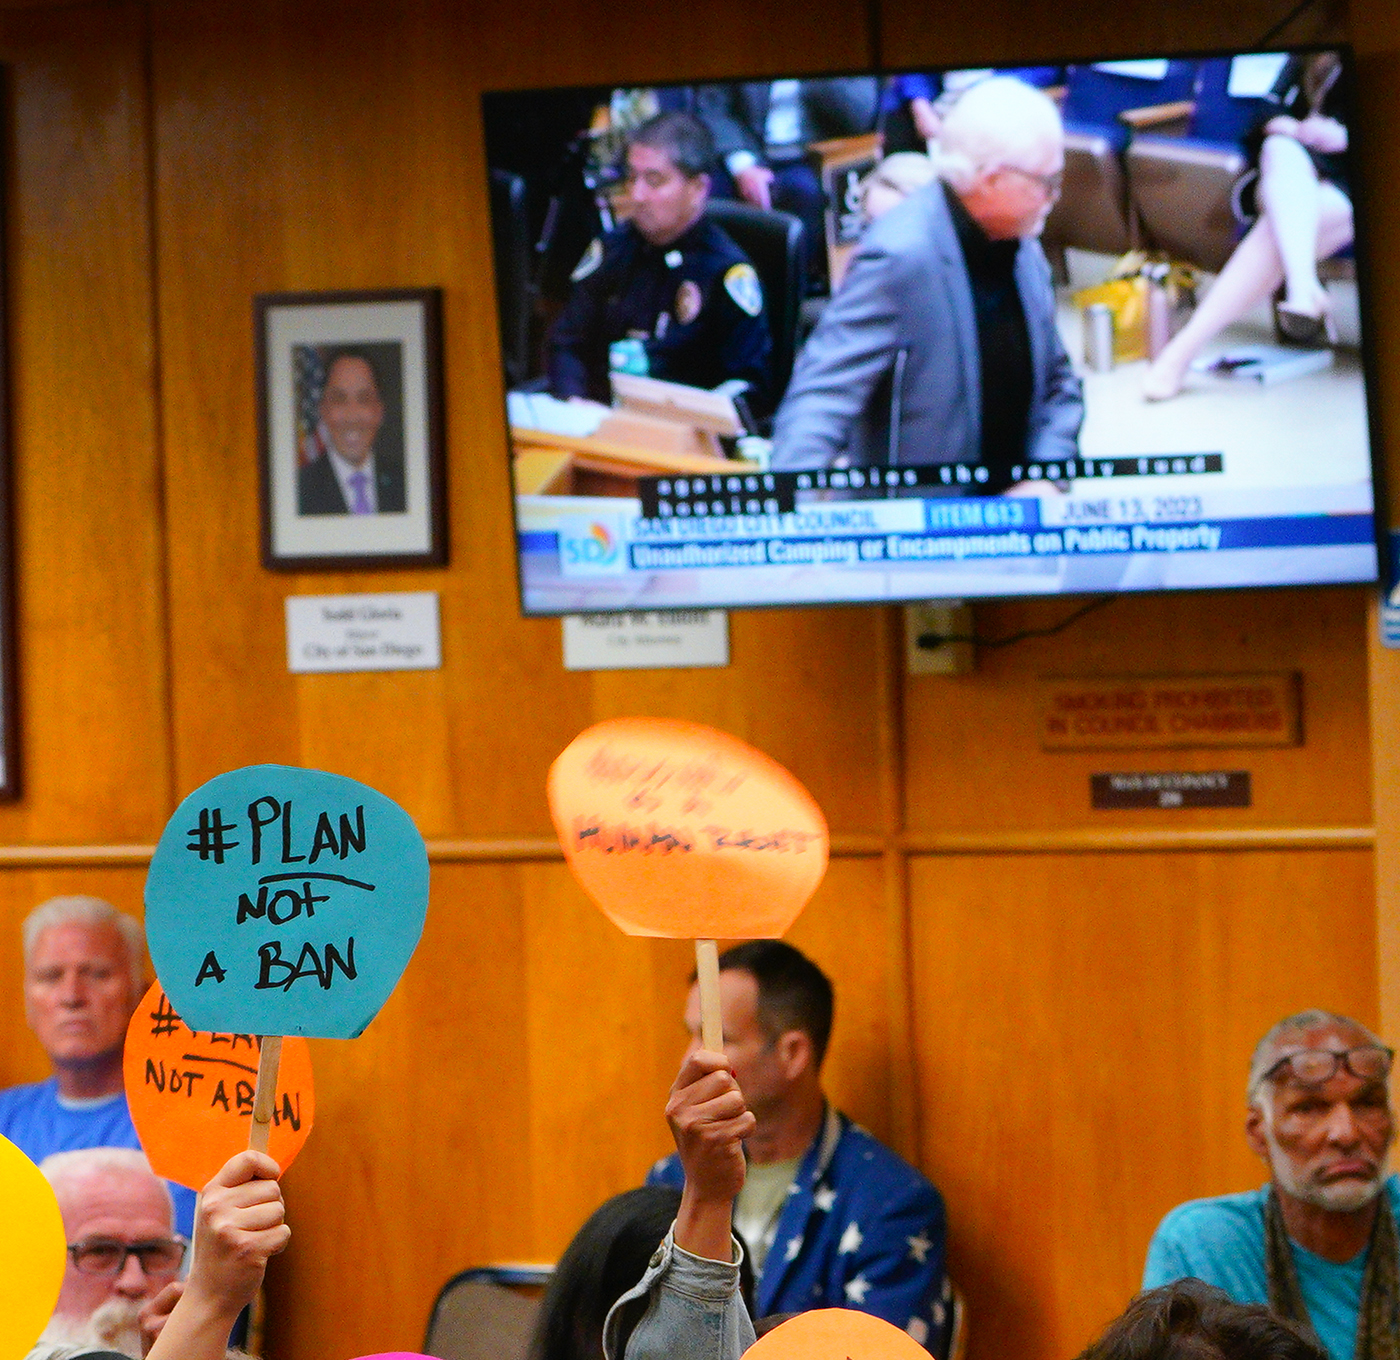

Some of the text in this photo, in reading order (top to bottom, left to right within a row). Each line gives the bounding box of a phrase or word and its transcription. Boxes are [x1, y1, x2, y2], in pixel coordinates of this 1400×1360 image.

[794, 509, 878, 530] COUNCIL
[930, 502, 1025, 528] ITEM 613
[1064, 499, 1108, 521] JUNE
[1154, 497, 1201, 518] 2023
[634, 523, 1221, 566] Unauthorized Camping or Encampments on Public Property
[186, 795, 367, 866] #PLAN
[195, 937, 358, 992] A BAN
[145, 1058, 204, 1096] NOT
